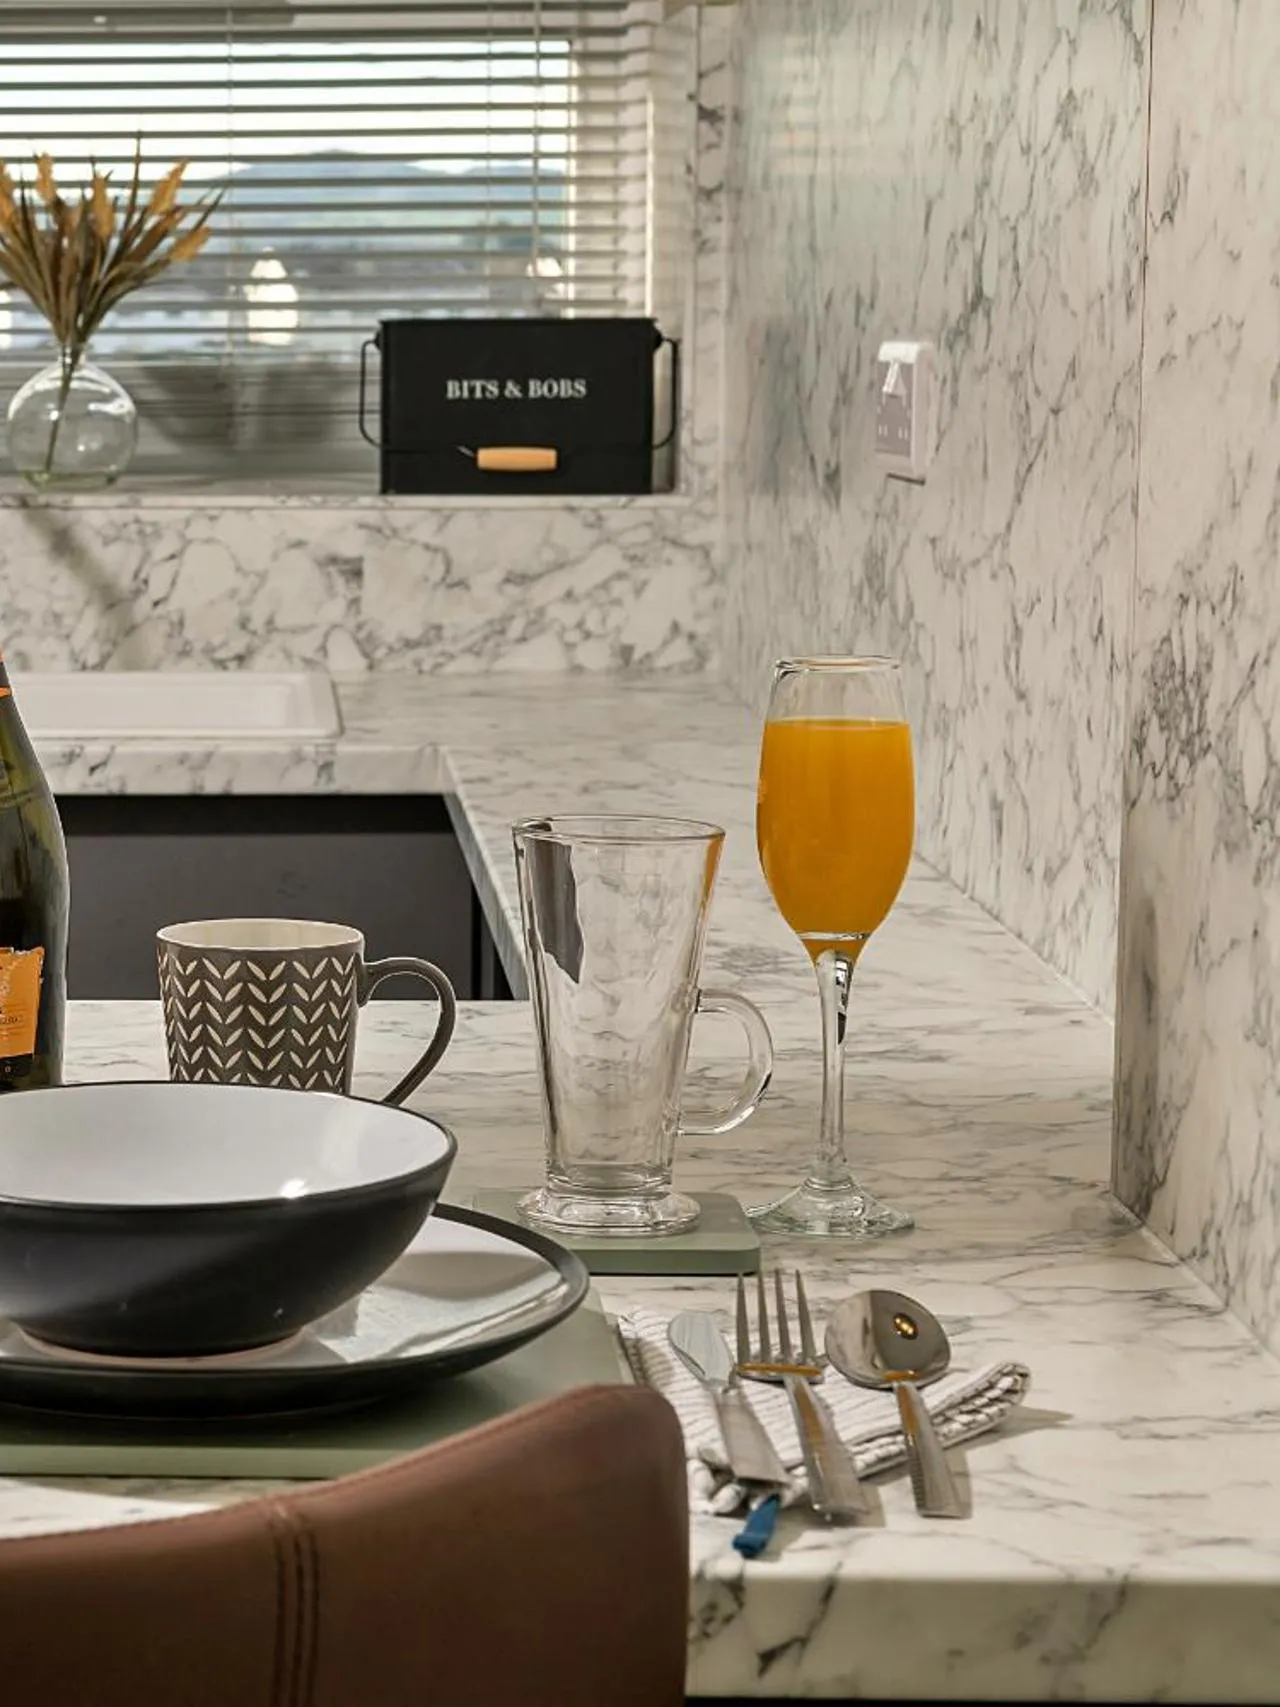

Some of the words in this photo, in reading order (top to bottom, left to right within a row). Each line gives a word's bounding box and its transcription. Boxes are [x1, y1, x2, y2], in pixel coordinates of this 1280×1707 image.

[446, 379, 499, 399] BITS
[504, 379, 522, 398] &
[528, 378, 588, 398] BOBS
